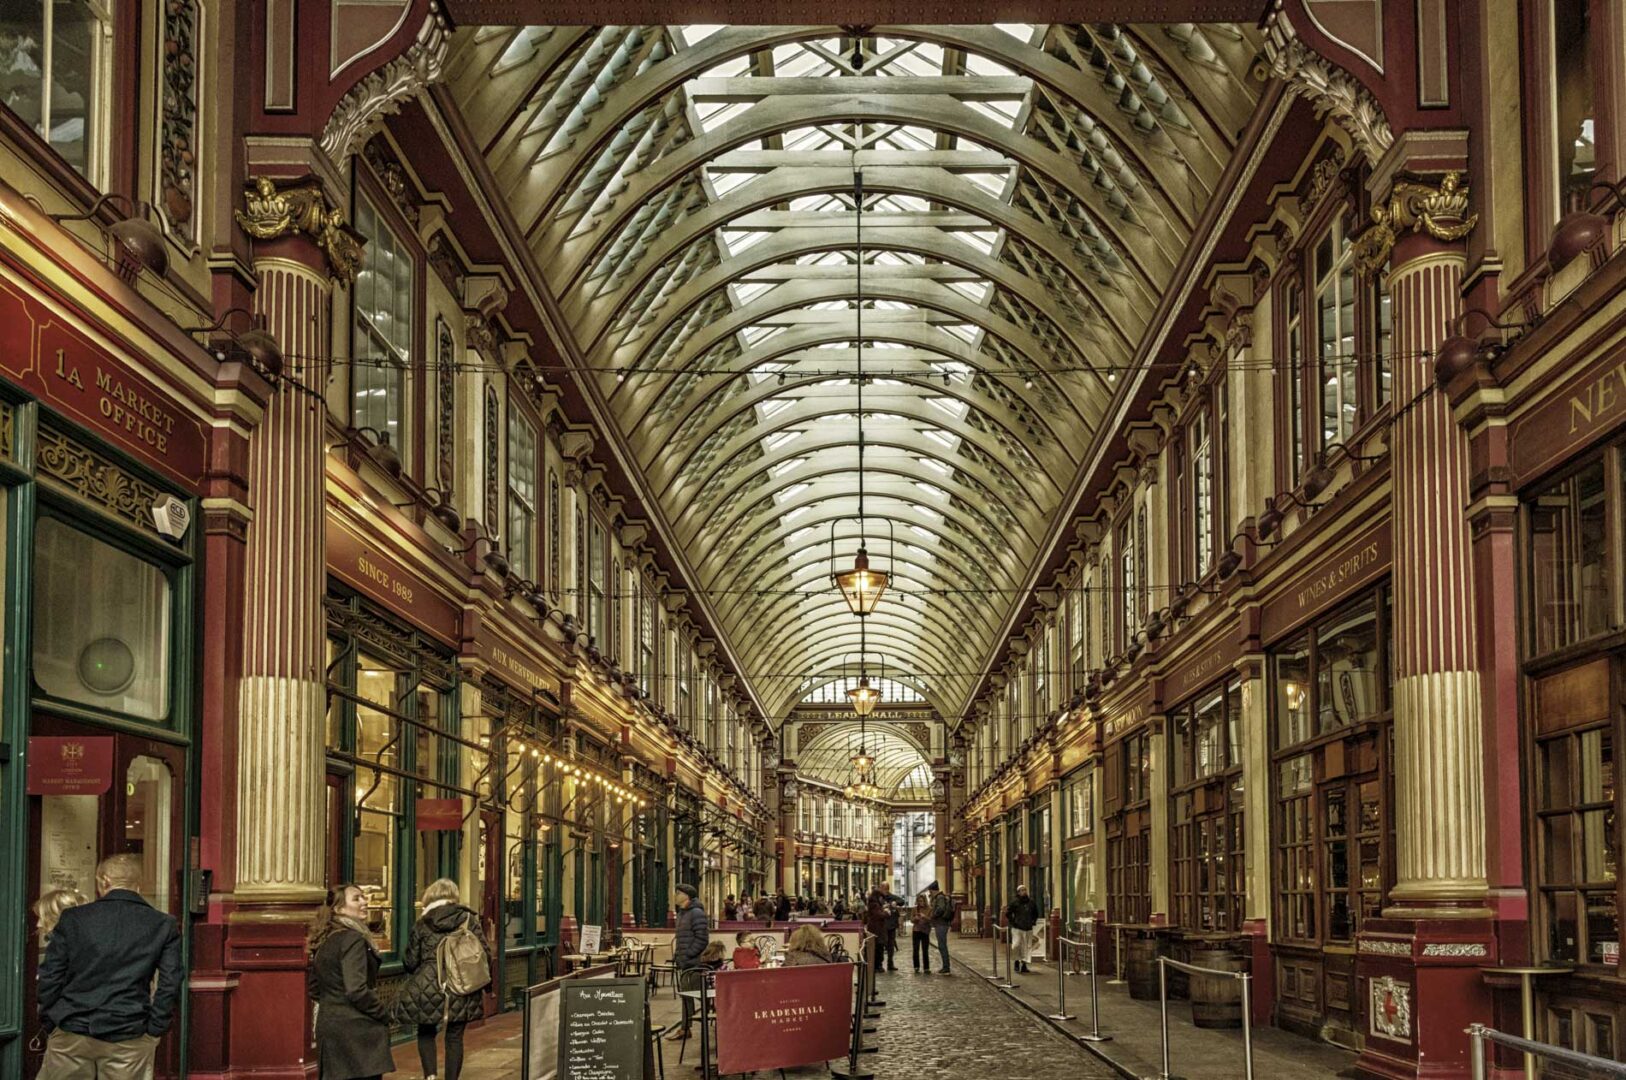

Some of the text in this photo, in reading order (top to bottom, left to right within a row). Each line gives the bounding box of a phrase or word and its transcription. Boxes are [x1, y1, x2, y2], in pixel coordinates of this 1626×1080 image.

[56, 348, 175, 435] 1A MARKET
[100, 397, 167, 454] OFFICE
[358, 556, 413, 604] SINCE 1982
[1298, 542, 1378, 608] WINES & SPIRITS
[492, 647, 508, 667] AUX
[827, 711, 902, 719] LEADHALL
[754, 1005, 824, 1019] LEADENHALL
[771, 1015, 809, 1024] MARKET
